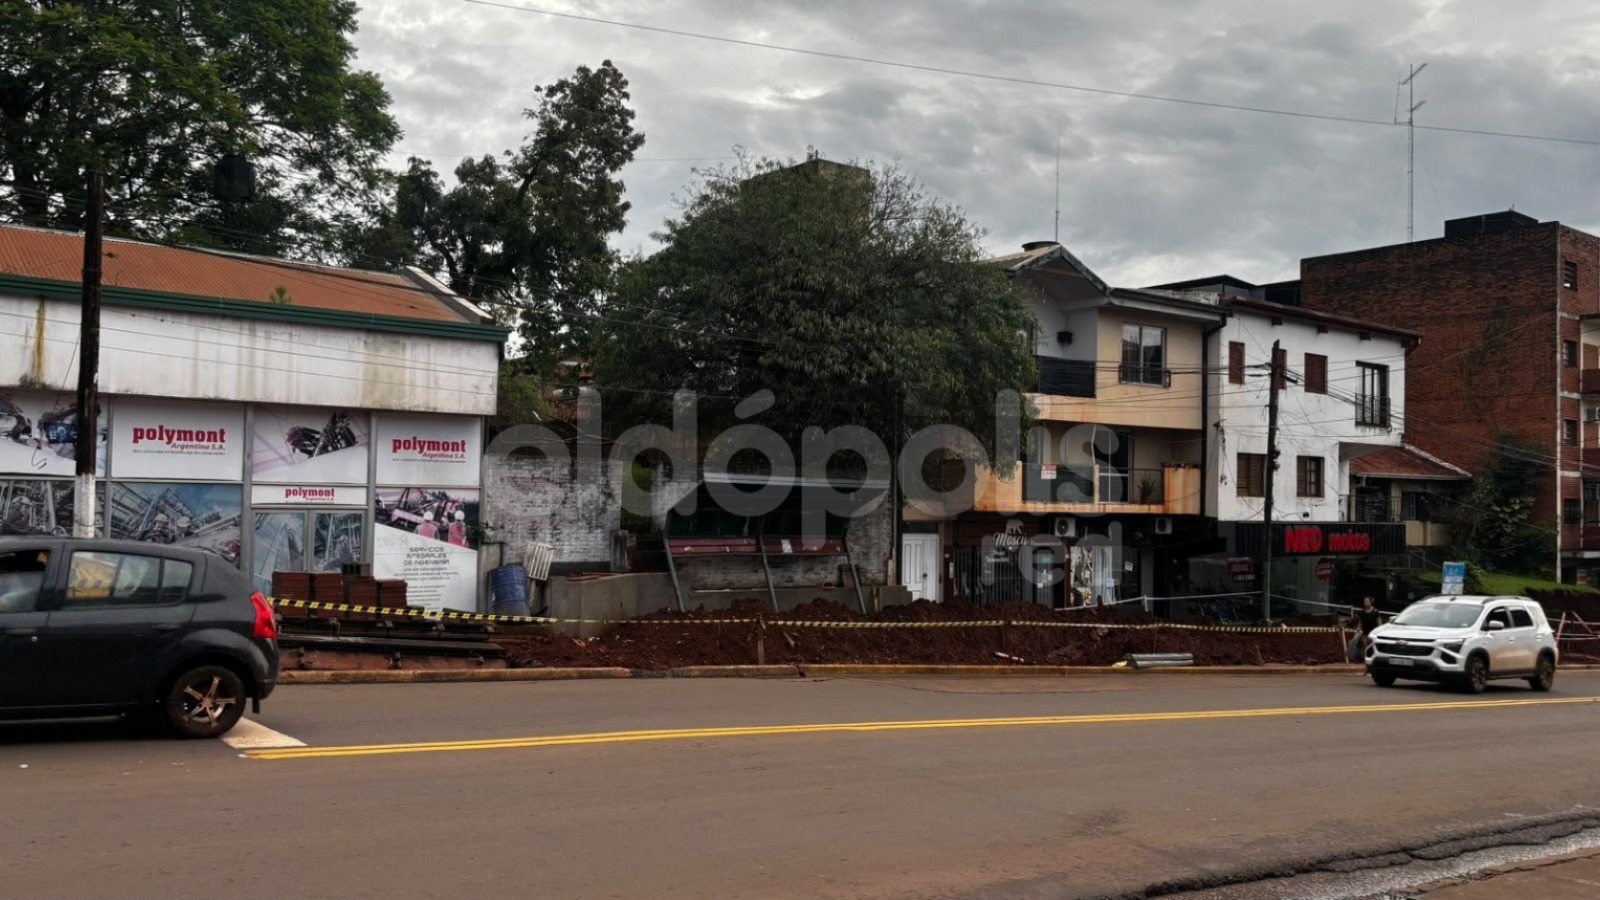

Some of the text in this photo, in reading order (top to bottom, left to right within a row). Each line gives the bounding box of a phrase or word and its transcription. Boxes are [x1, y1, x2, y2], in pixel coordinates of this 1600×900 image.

[132, 424, 226, 445] polymont
[392, 436, 466, 454] polymont
[285, 486, 335, 498] polymont
[993, 531, 1028, 547] Moscú
[1285, 526, 1371, 553] NEO motos
